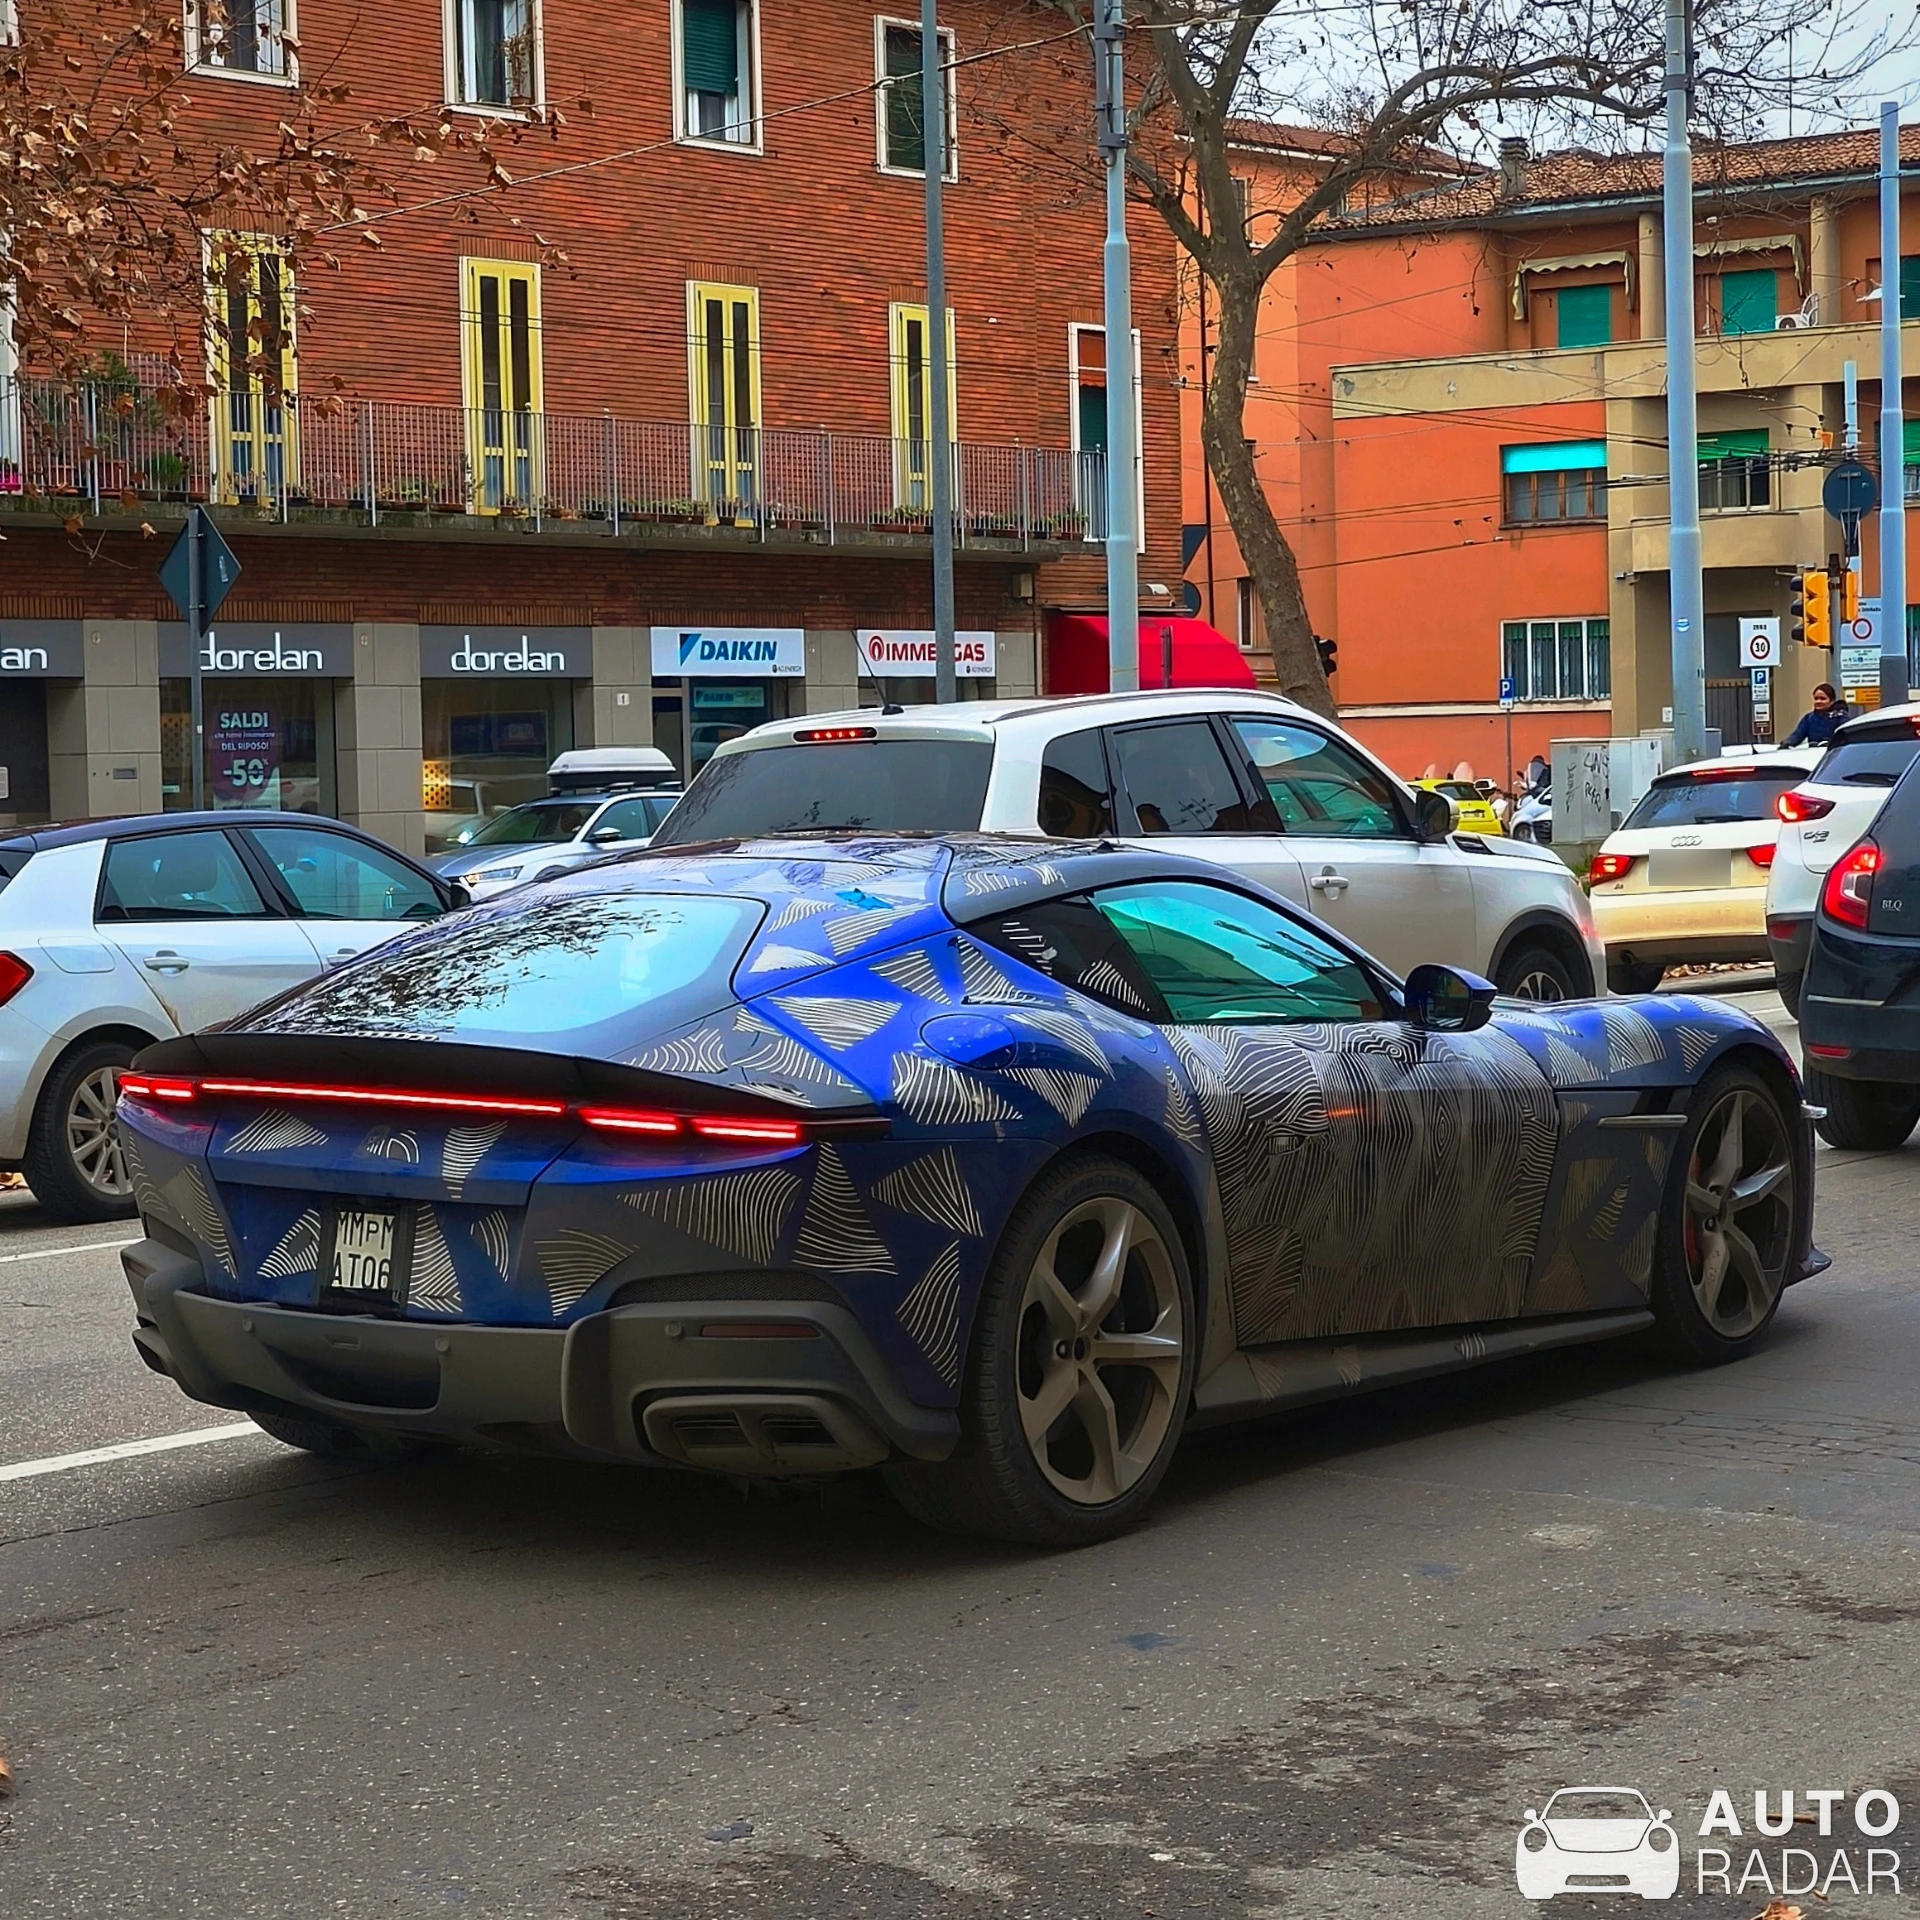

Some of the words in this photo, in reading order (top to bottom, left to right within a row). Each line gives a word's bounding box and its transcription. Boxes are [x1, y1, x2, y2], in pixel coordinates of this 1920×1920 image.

[200, 631, 323, 670] dorelan
[451, 634, 565, 671] dorelan
[700, 640, 777, 661] DAIKIN
[886, 643, 985, 661] IMMEGAS
[1755, 642, 1766, 652] 30
[1757, 672, 1764, 682] P
[1502, 681, 1510, 697] P
[220, 712, 268, 728] SALDI
[221, 742, 236, 751] DEL
[238, 741, 269, 750] RIPOSO!
